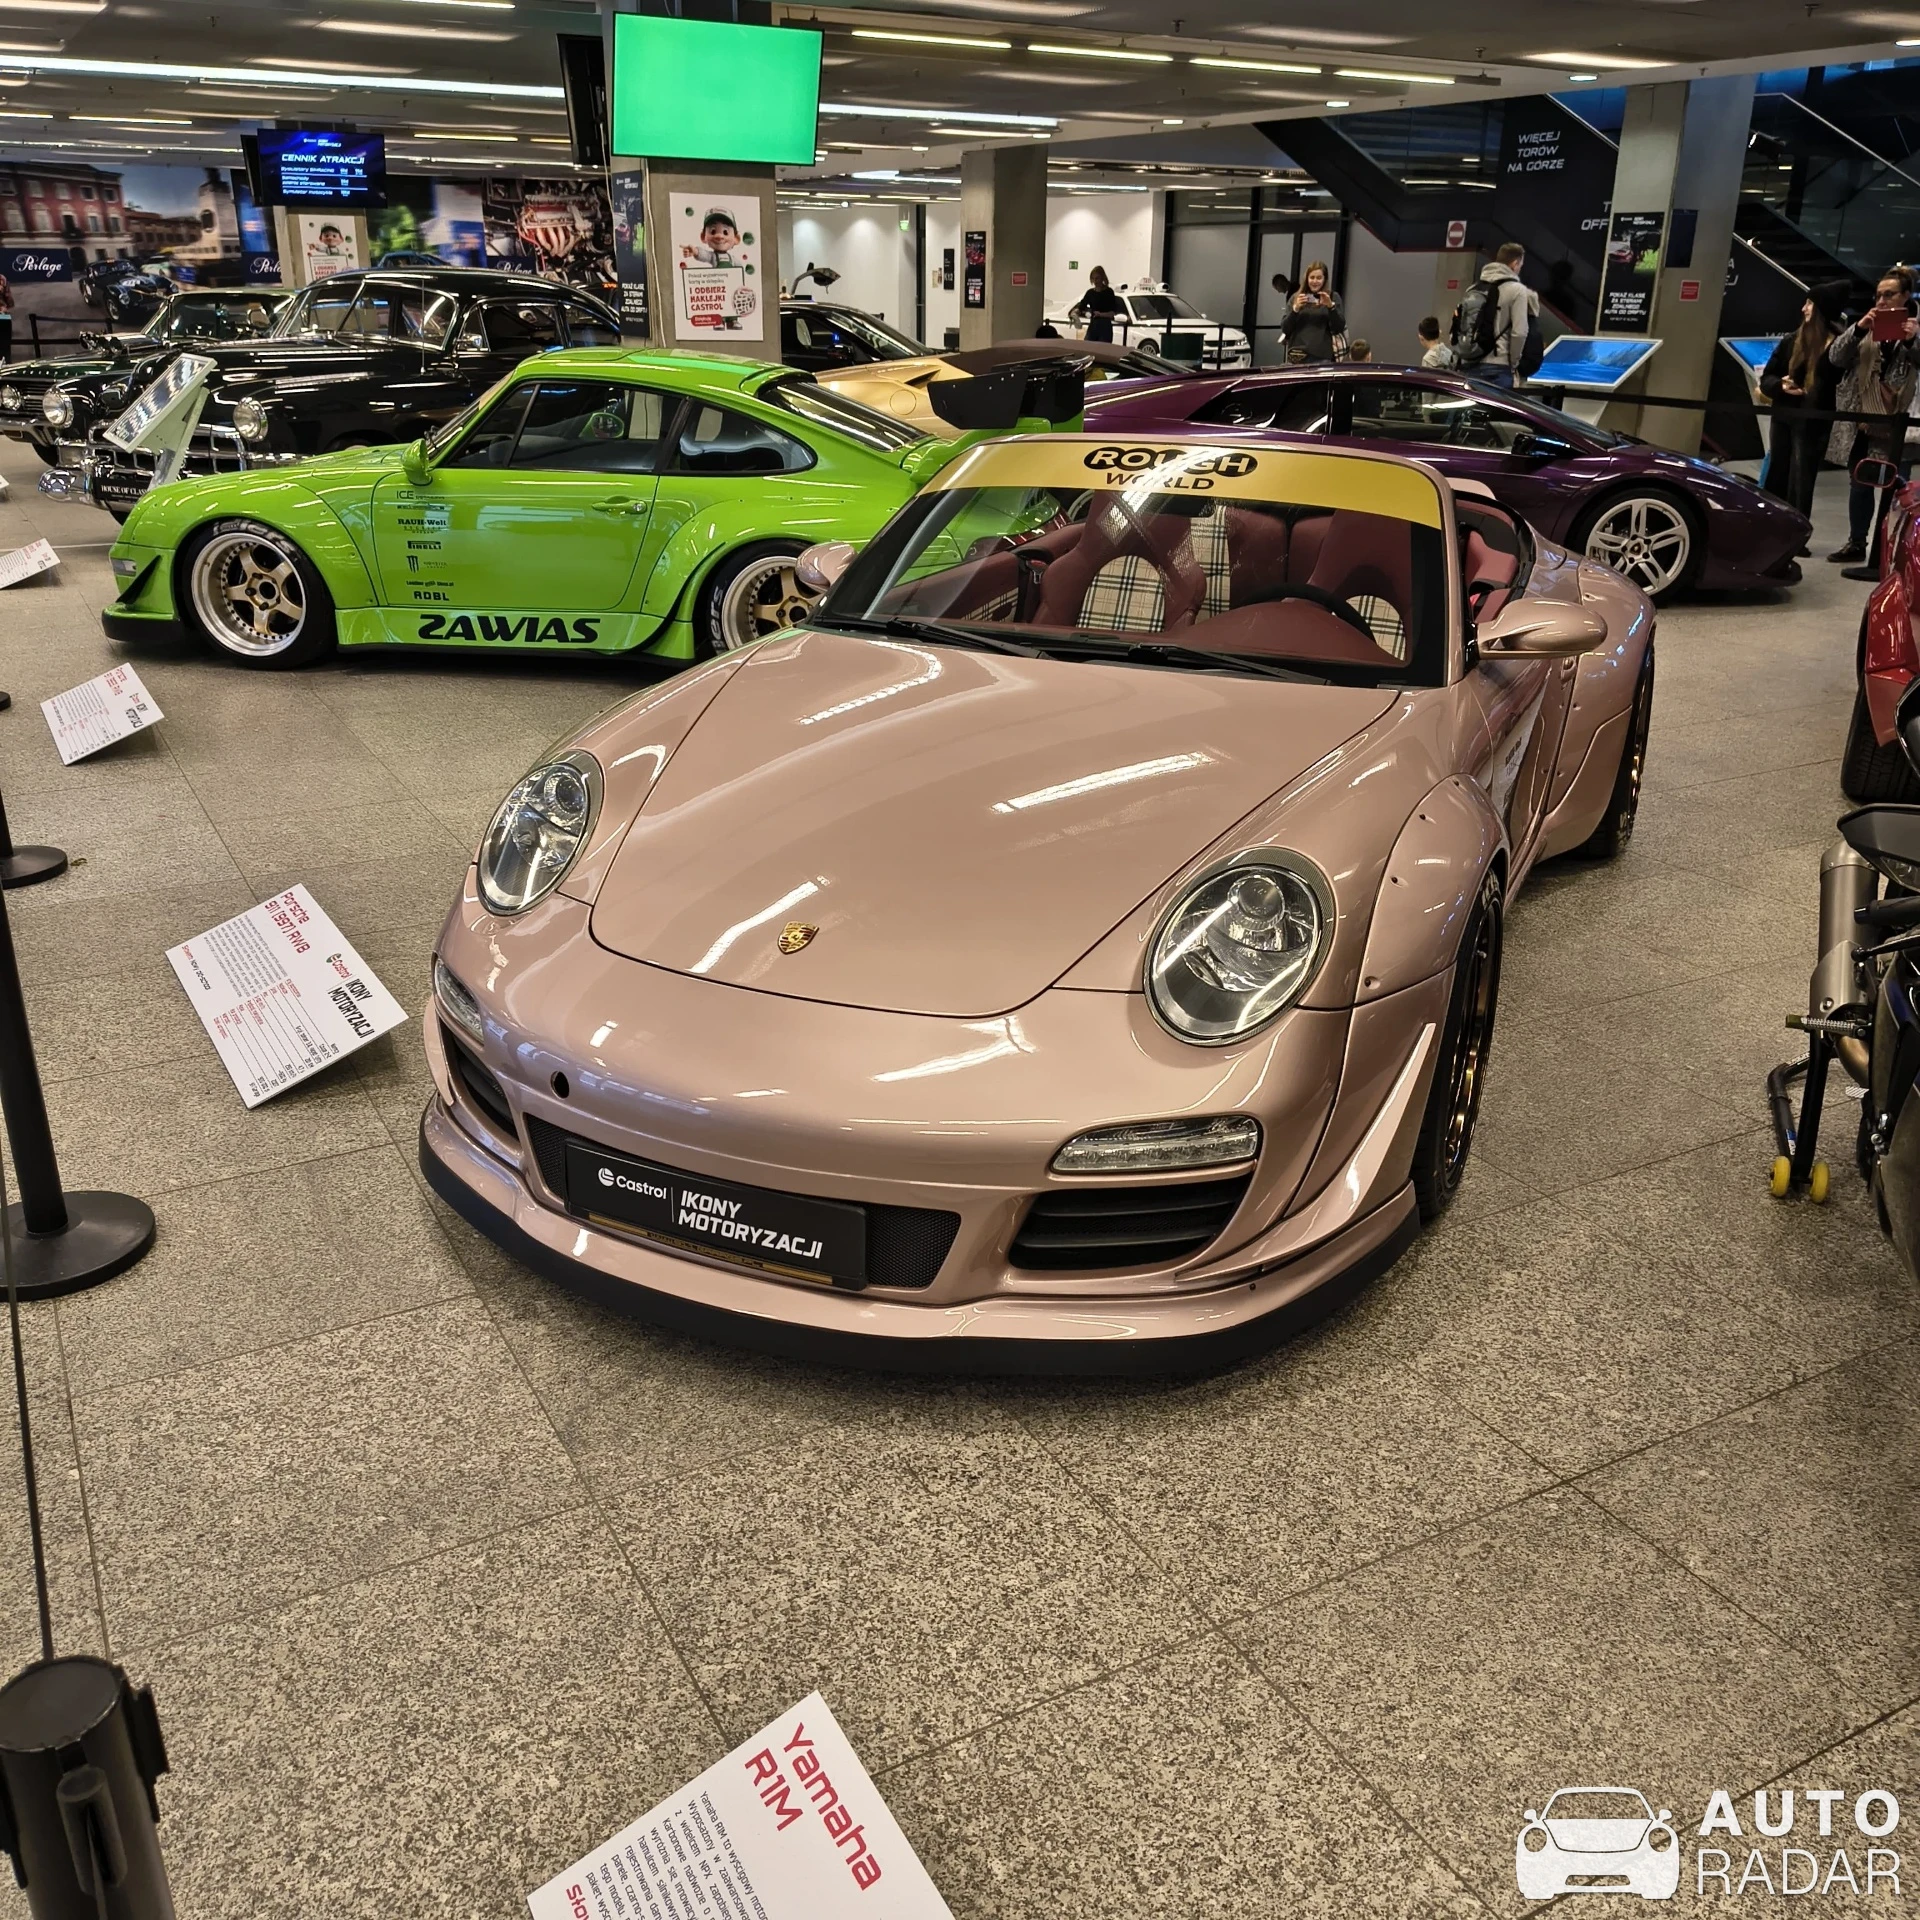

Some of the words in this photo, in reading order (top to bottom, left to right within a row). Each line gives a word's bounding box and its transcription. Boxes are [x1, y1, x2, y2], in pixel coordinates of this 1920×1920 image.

[1517, 145, 1559, 158] TORÓW
[1518, 131, 1561, 144] WIĘCEJ
[281, 153, 317, 162] CENNIK
[319, 155, 365, 165] ATRAKCJI
[1507, 162, 1523, 173] NA
[1526, 158, 1565, 172] GÓRZE
[12, 254, 63, 278] Perlage
[690, 295, 726, 303] NAKLEJKI
[695, 286, 727, 294] ODBIERZ
[691, 303, 723, 311] CASTROL
[396, 490, 414, 499] ICE
[397, 518, 447, 526] RAUH-Welt
[407, 540, 442, 550] PIRELLI
[280, 891, 310, 925] Porsche
[265, 900, 280, 920] 911
[287, 930, 311, 954] RWB
[332, 959, 353, 980] Castrol
[345, 978, 373, 1002] IKONY
[328, 986, 375, 1039] MOTORYZACJI
[616, 1175, 667, 1200] Castrol
[681, 1190, 742, 1219] IKONY
[678, 1209, 823, 1259] MOTORYZACJI
[744, 1747, 804, 1832] R1M
[783, 1722, 882, 1891] Yamaha
[674, 1809, 683, 1817] z
[679, 1819, 702, 1858] widelcem
[698, 1859, 714, 1880] NPX
[687, 1799, 716, 1851] Wyposażony
[713, 1853, 722, 1864] w
[700, 1790, 719, 1823] Yamaha
[715, 1821, 728, 1840] R1M
[722, 1838, 732, 1851] to
[728, 1849, 755, 1896] wyścigowy
[611, 1853, 629, 1885] panele,
[636, 1834, 660, 1877] hamulcem
[650, 1826, 671, 1865] wyróżnia
[667, 1865, 679, 1883] się
[662, 1817, 688, 1863] Karbonowe
[683, 1864, 707, 1905] nadwozie
[703, 1906, 712, 1916] o
[585, 1871, 602, 1900] pakiet
[624, 1844, 654, 1902] rejestrowania
[600, 1862, 612, 1884] tego
[608, 1884, 626, 1918] modelu.
